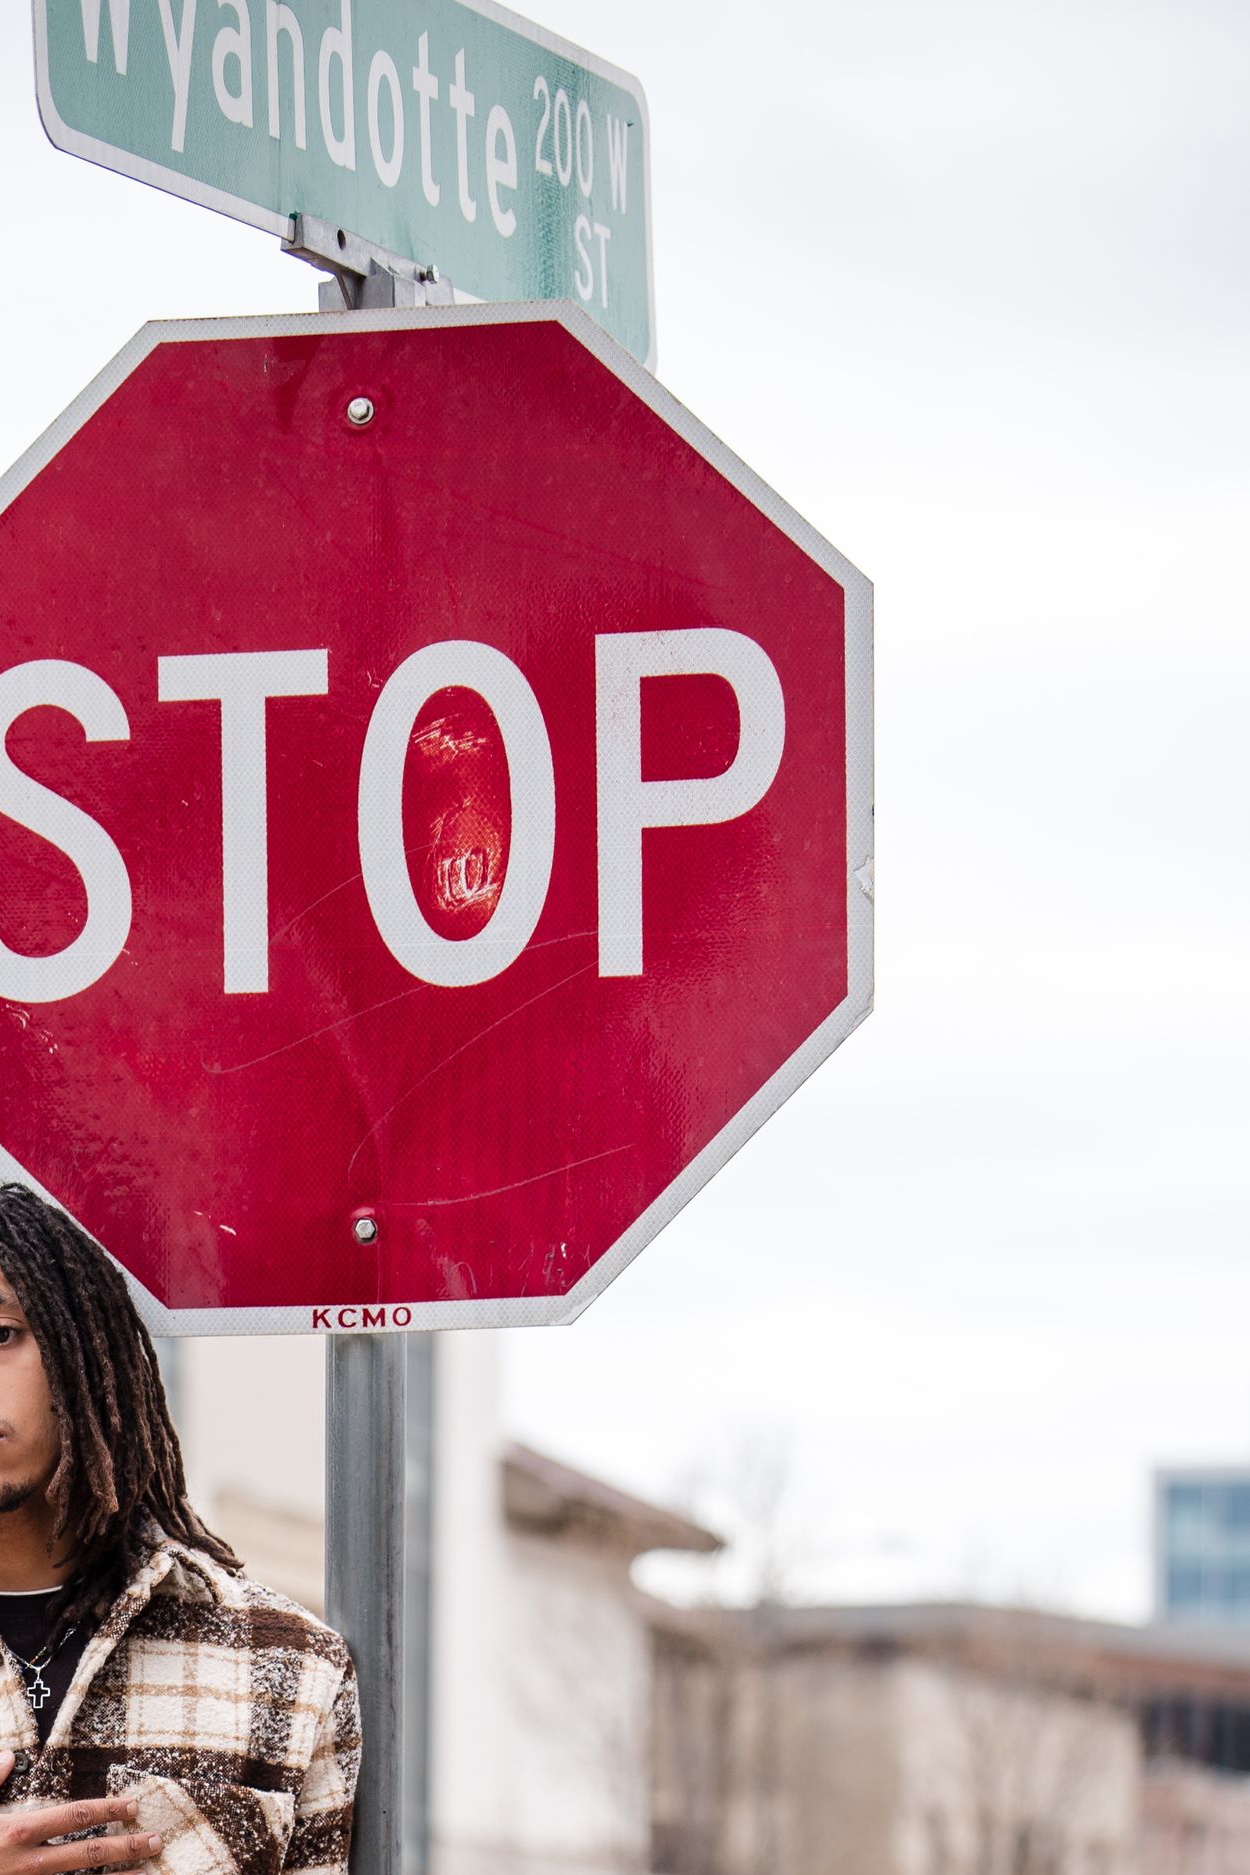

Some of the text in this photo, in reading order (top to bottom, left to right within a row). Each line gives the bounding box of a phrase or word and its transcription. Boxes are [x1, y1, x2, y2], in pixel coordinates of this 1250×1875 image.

[533, 76, 628, 214] 200 W
[574, 214, 611, 309] ST
[312, 1306, 412, 1329] KCMO
